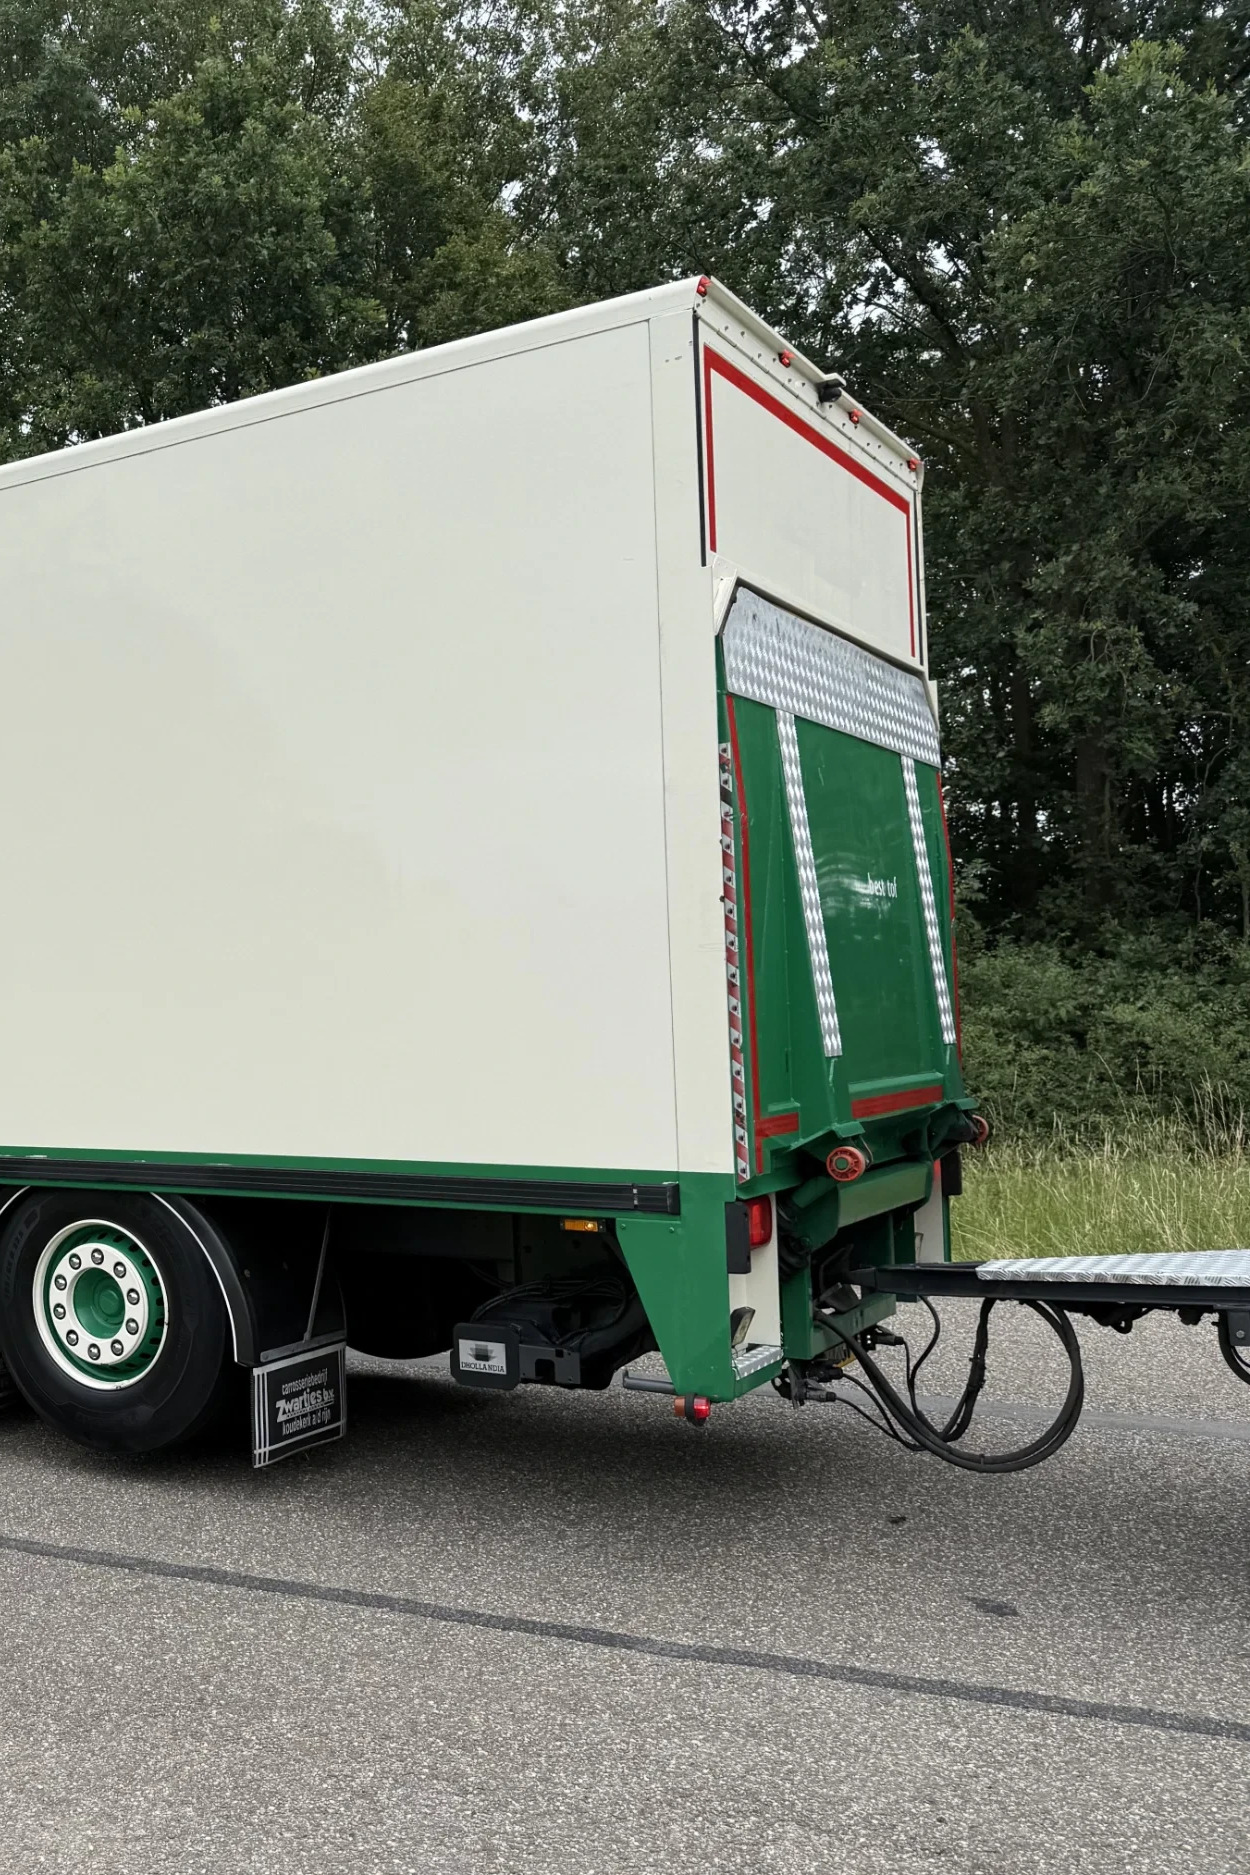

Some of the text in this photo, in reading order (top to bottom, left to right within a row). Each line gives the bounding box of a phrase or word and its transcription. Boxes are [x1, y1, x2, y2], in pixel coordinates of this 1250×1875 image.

[867, 871, 886, 896] best
[281, 1367, 328, 1396] carrosseriebedrijf
[460, 1361, 505, 1373] DHOLLANDIA
[276, 1388, 323, 1423] Zwartjes
[282, 1413, 311, 1437] koudekerk
[322, 1407, 332, 1425] rijn
